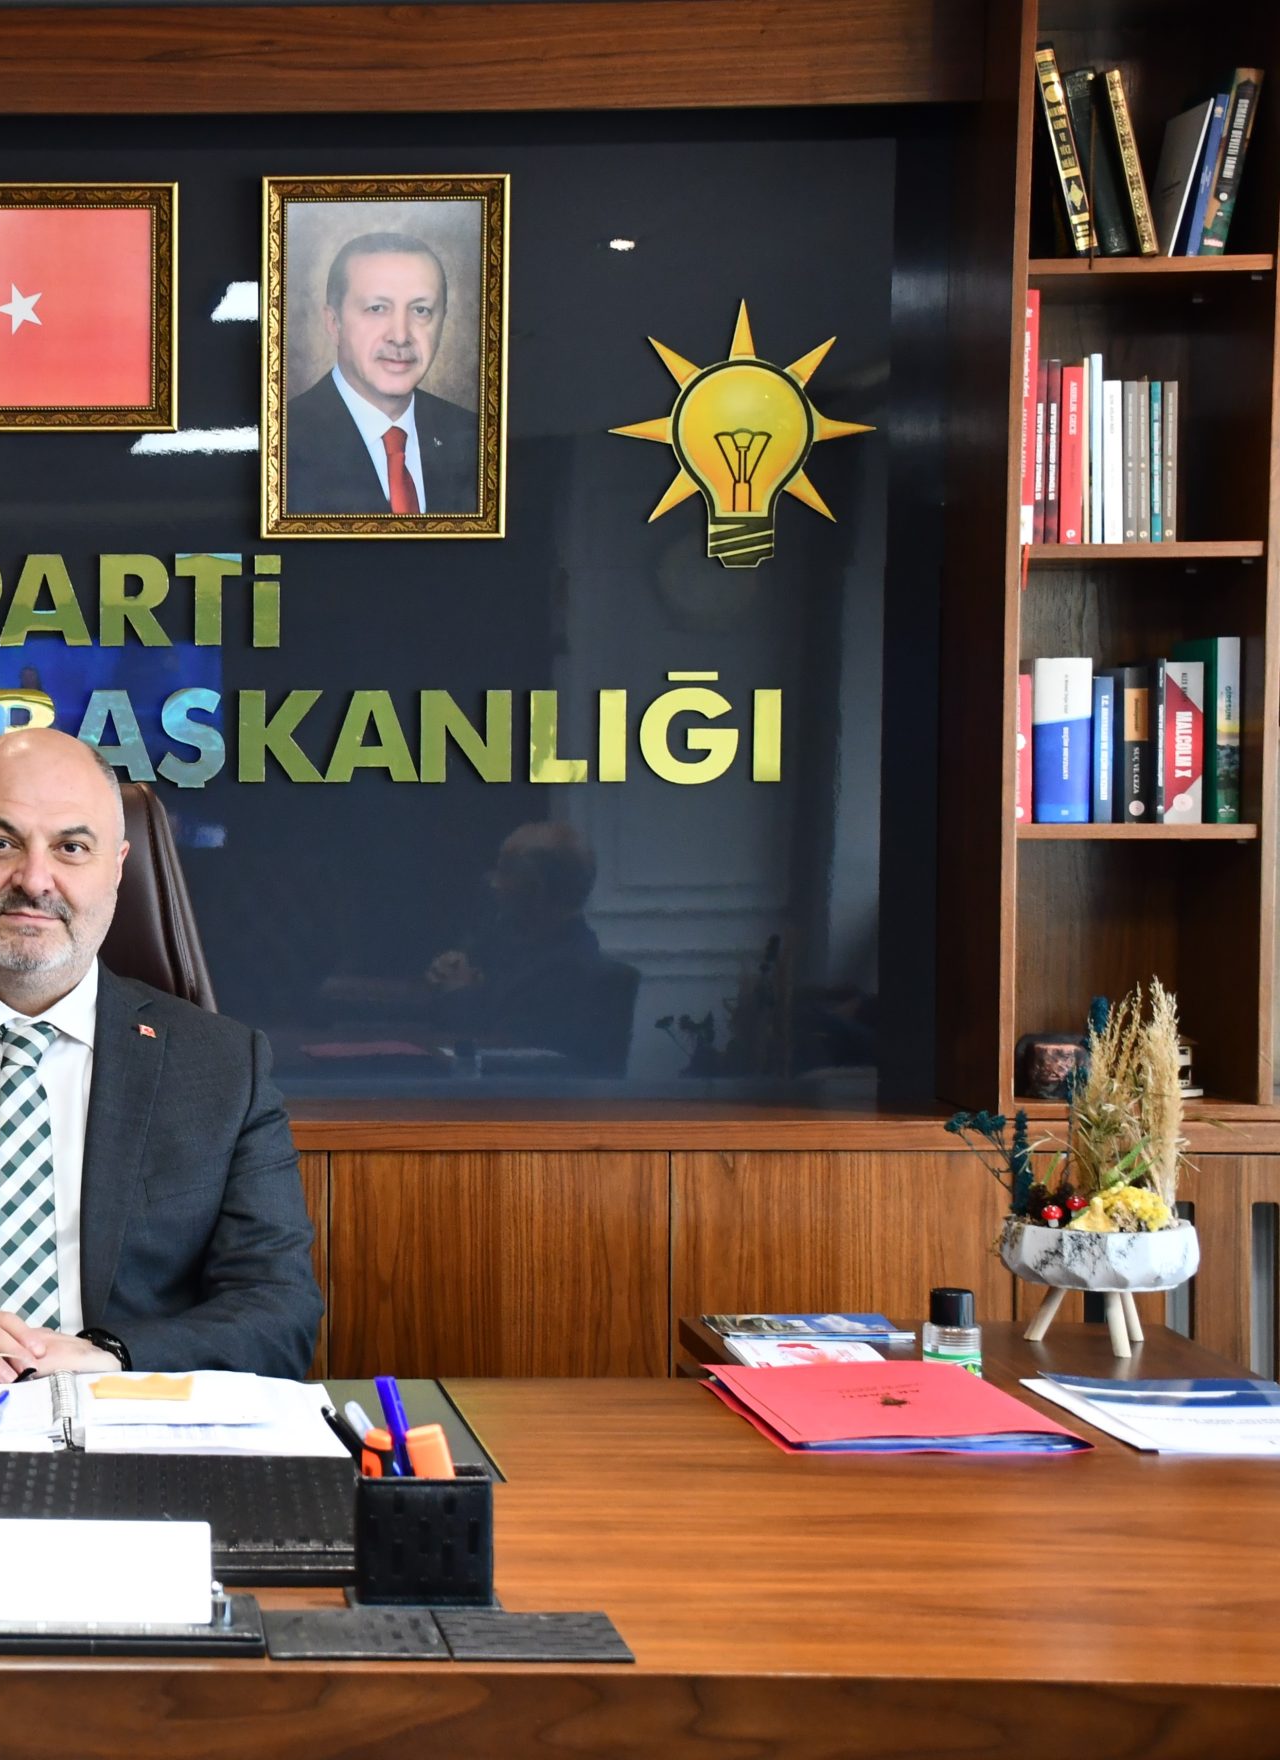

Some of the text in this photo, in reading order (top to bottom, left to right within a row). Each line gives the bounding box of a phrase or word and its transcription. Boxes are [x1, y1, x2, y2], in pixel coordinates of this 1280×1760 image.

[1175, 711, 1193, 767] MALCOLM
[1131, 747, 1140, 794] SUÇ VE CEZA
[1174, 768, 1192, 779] X
